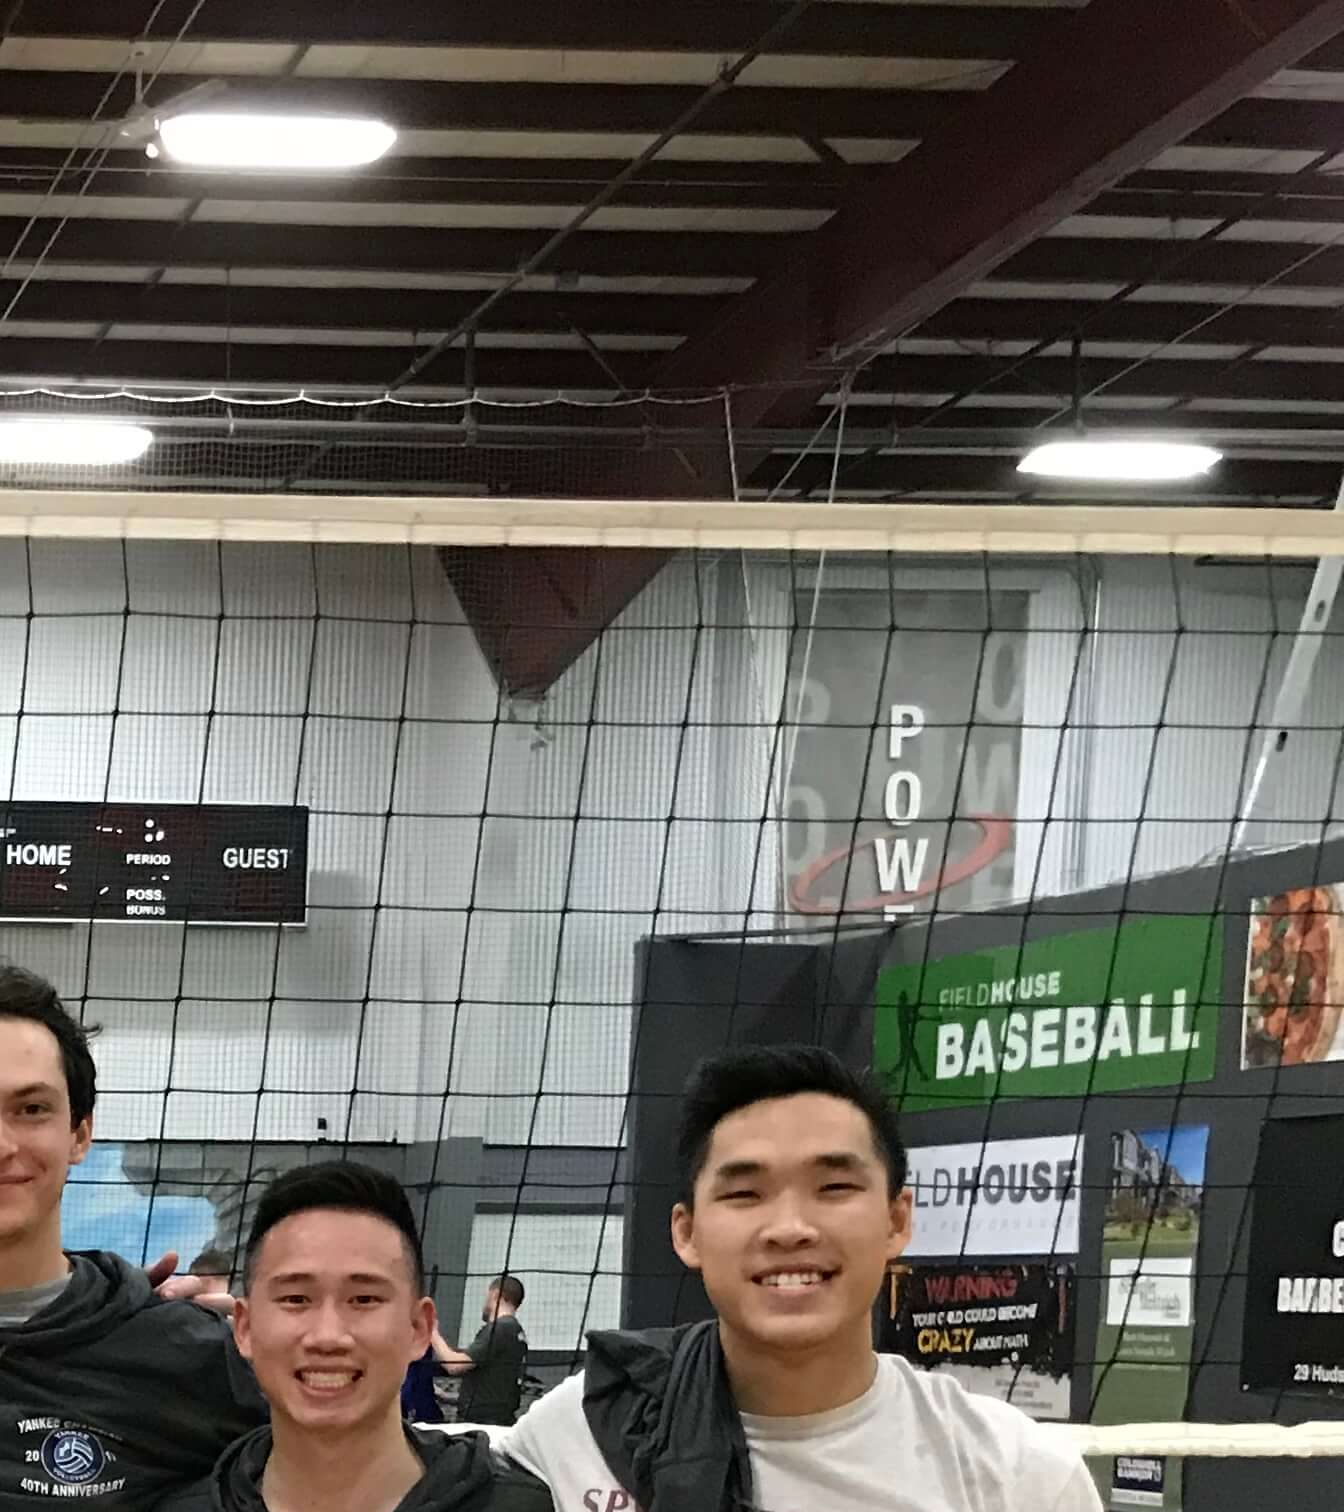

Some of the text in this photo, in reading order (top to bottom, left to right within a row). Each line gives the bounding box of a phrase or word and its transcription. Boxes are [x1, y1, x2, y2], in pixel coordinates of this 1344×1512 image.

[6, 844, 73, 866] HOME
[126, 853, 171, 866] PERIOD
[223, 848, 290, 870] GUEST
[939, 971, 1062, 1012] FIELDHOUSE
[936, 988, 1201, 1080] BASEBALL
[909, 1160, 1078, 1208] LDHOUSE
[924, 1272, 1019, 1303] WARNING
[917, 1327, 975, 1354] CRAZY
[1293, 1363, 1309, 1381] 29
[24, 1450, 40, 1463] 20
[20, 1477, 127, 1497] 40TH ANNIVERSARY
